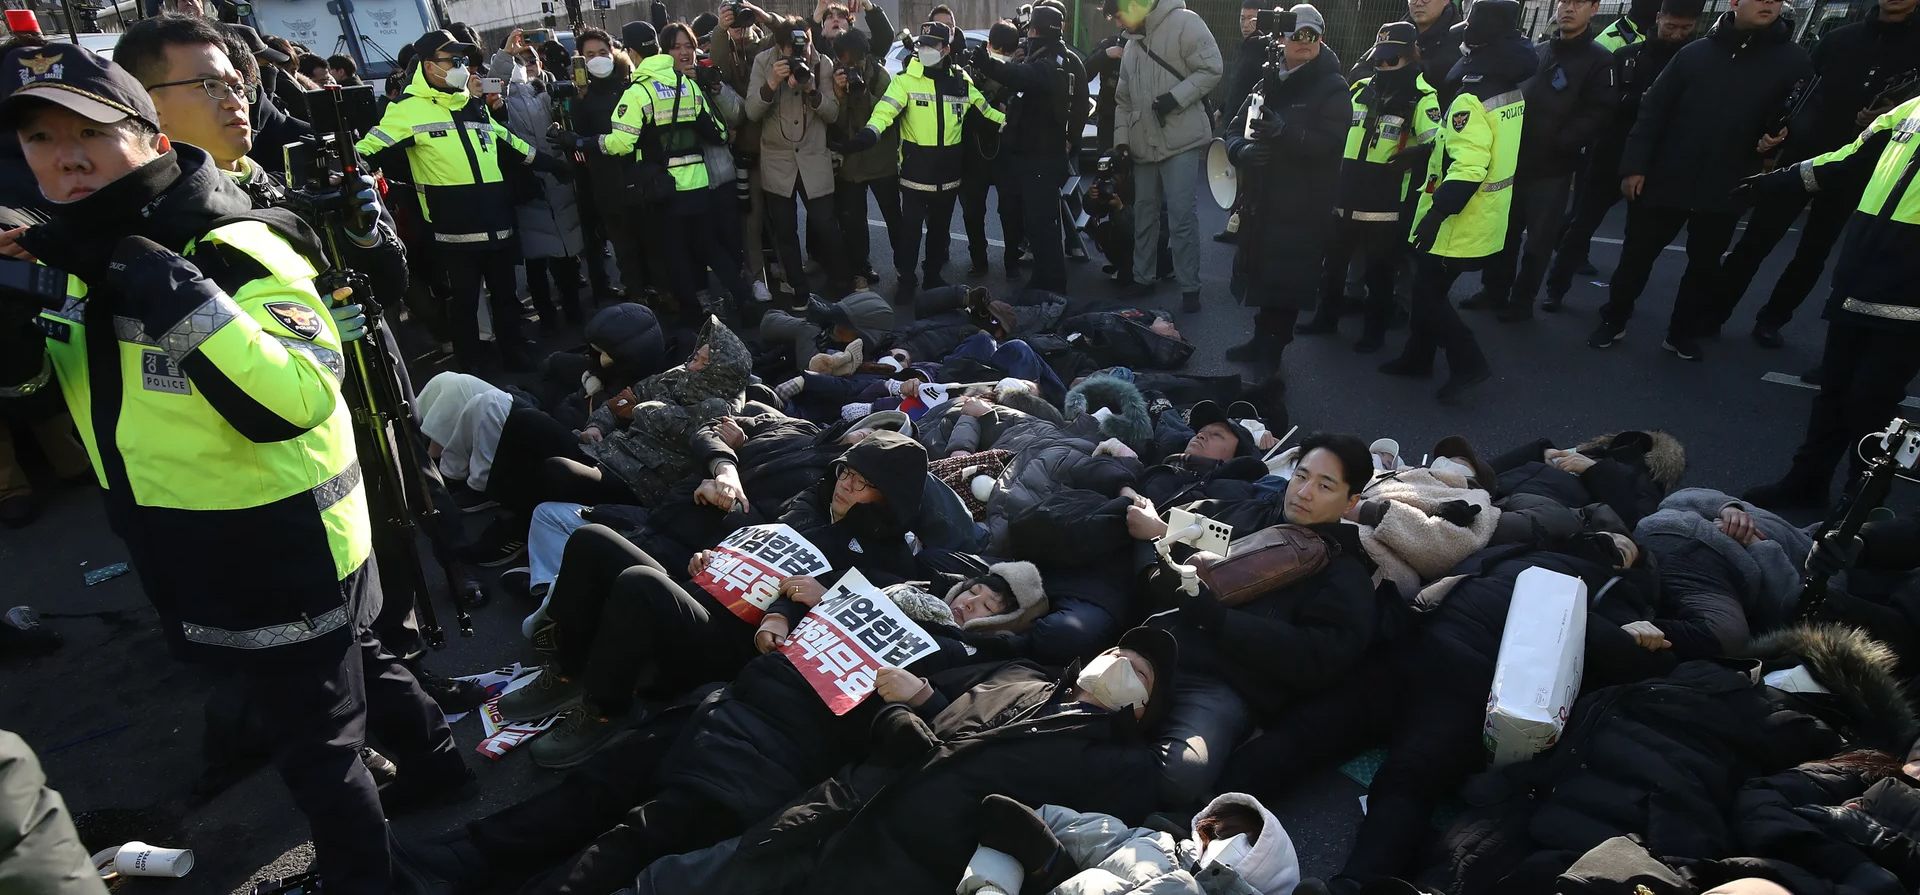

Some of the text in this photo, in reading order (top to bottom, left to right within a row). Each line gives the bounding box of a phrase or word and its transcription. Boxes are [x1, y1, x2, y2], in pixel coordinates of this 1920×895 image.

[147, 377, 185, 390] POLICE
[722, 527, 825, 577] 계엄합법
[703, 551, 782, 612] 핵무효
[819, 584, 931, 667] 계엄합법
[136, 851, 145, 868] EDIYA
[141, 850, 152, 871] COFFEE
